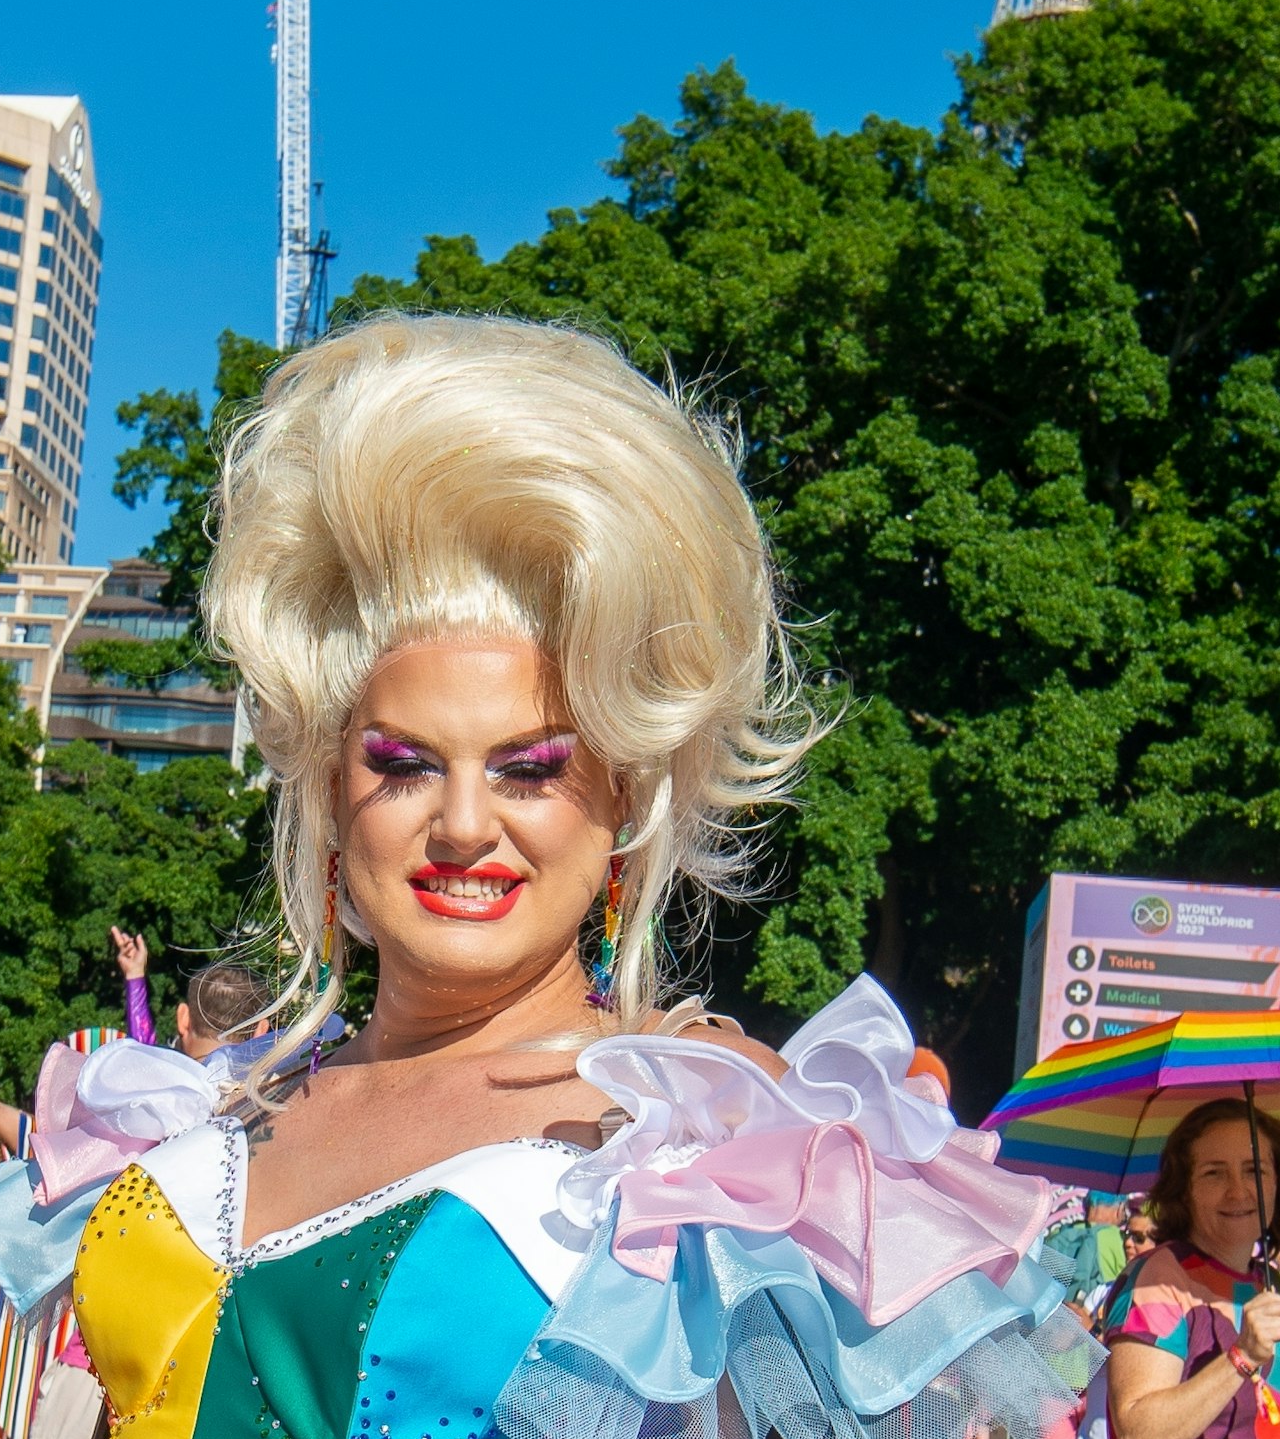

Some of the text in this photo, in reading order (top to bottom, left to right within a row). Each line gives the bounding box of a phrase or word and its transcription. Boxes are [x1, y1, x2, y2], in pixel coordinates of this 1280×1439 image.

[1178, 902, 1224, 916] SYDNEY
[1176, 913, 1255, 930] WORLDPRIDE
[1176, 923, 1205, 936] 2023
[1108, 955, 1157, 971] Toilets
[1106, 989, 1161, 1006] Medical
